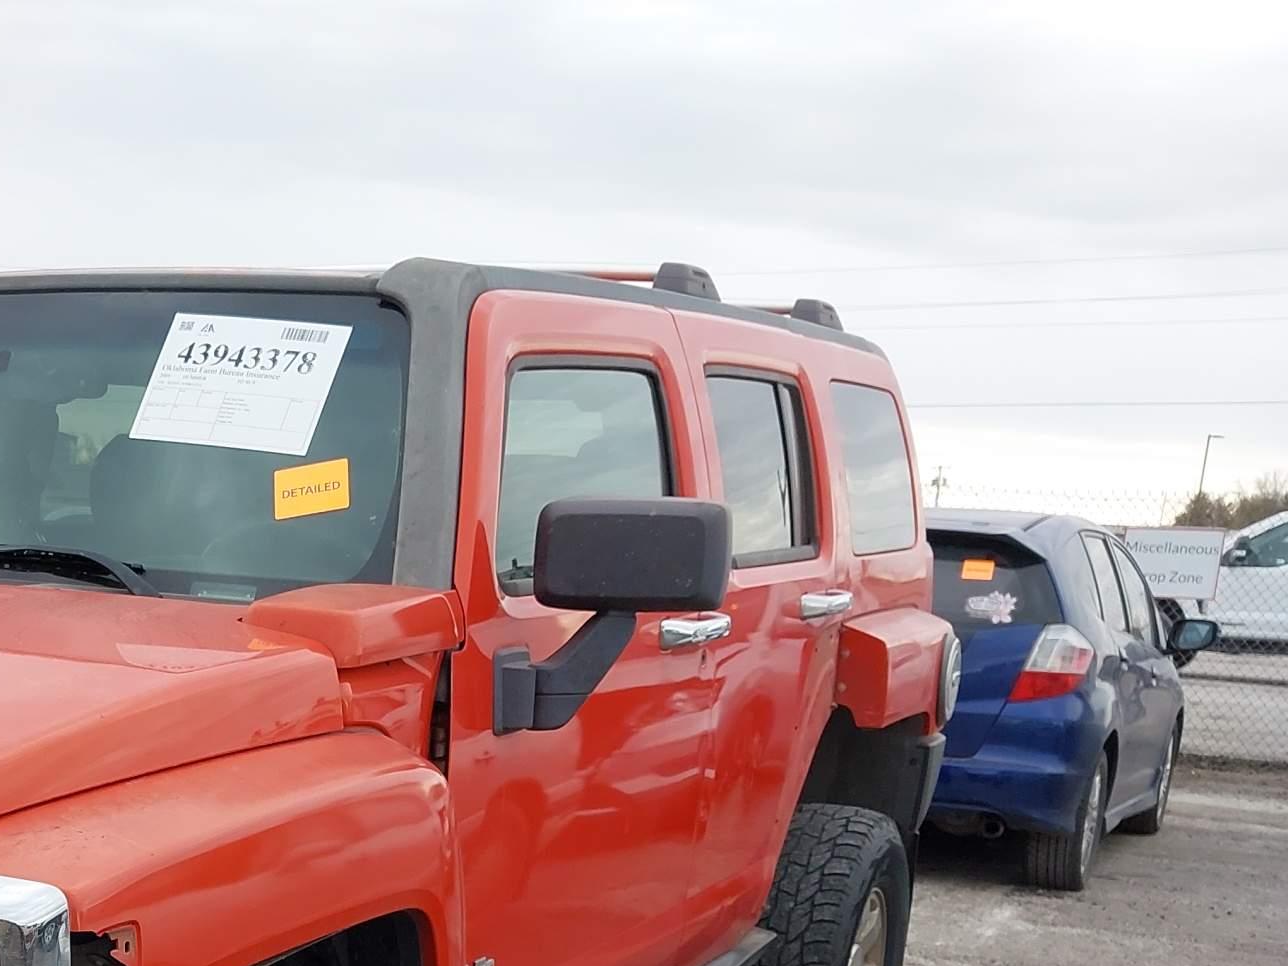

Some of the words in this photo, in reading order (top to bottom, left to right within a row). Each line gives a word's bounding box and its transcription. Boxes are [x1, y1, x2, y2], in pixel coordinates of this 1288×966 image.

[178, 342, 317, 375] 43943378
[246, 371, 280, 380] Insurance
[281, 481, 341, 500] DETAILED
[1125, 541, 1219, 556] Miscellaneous
[1145, 574, 1166, 585] rop
[1169, 571, 1203, 585] Zone
